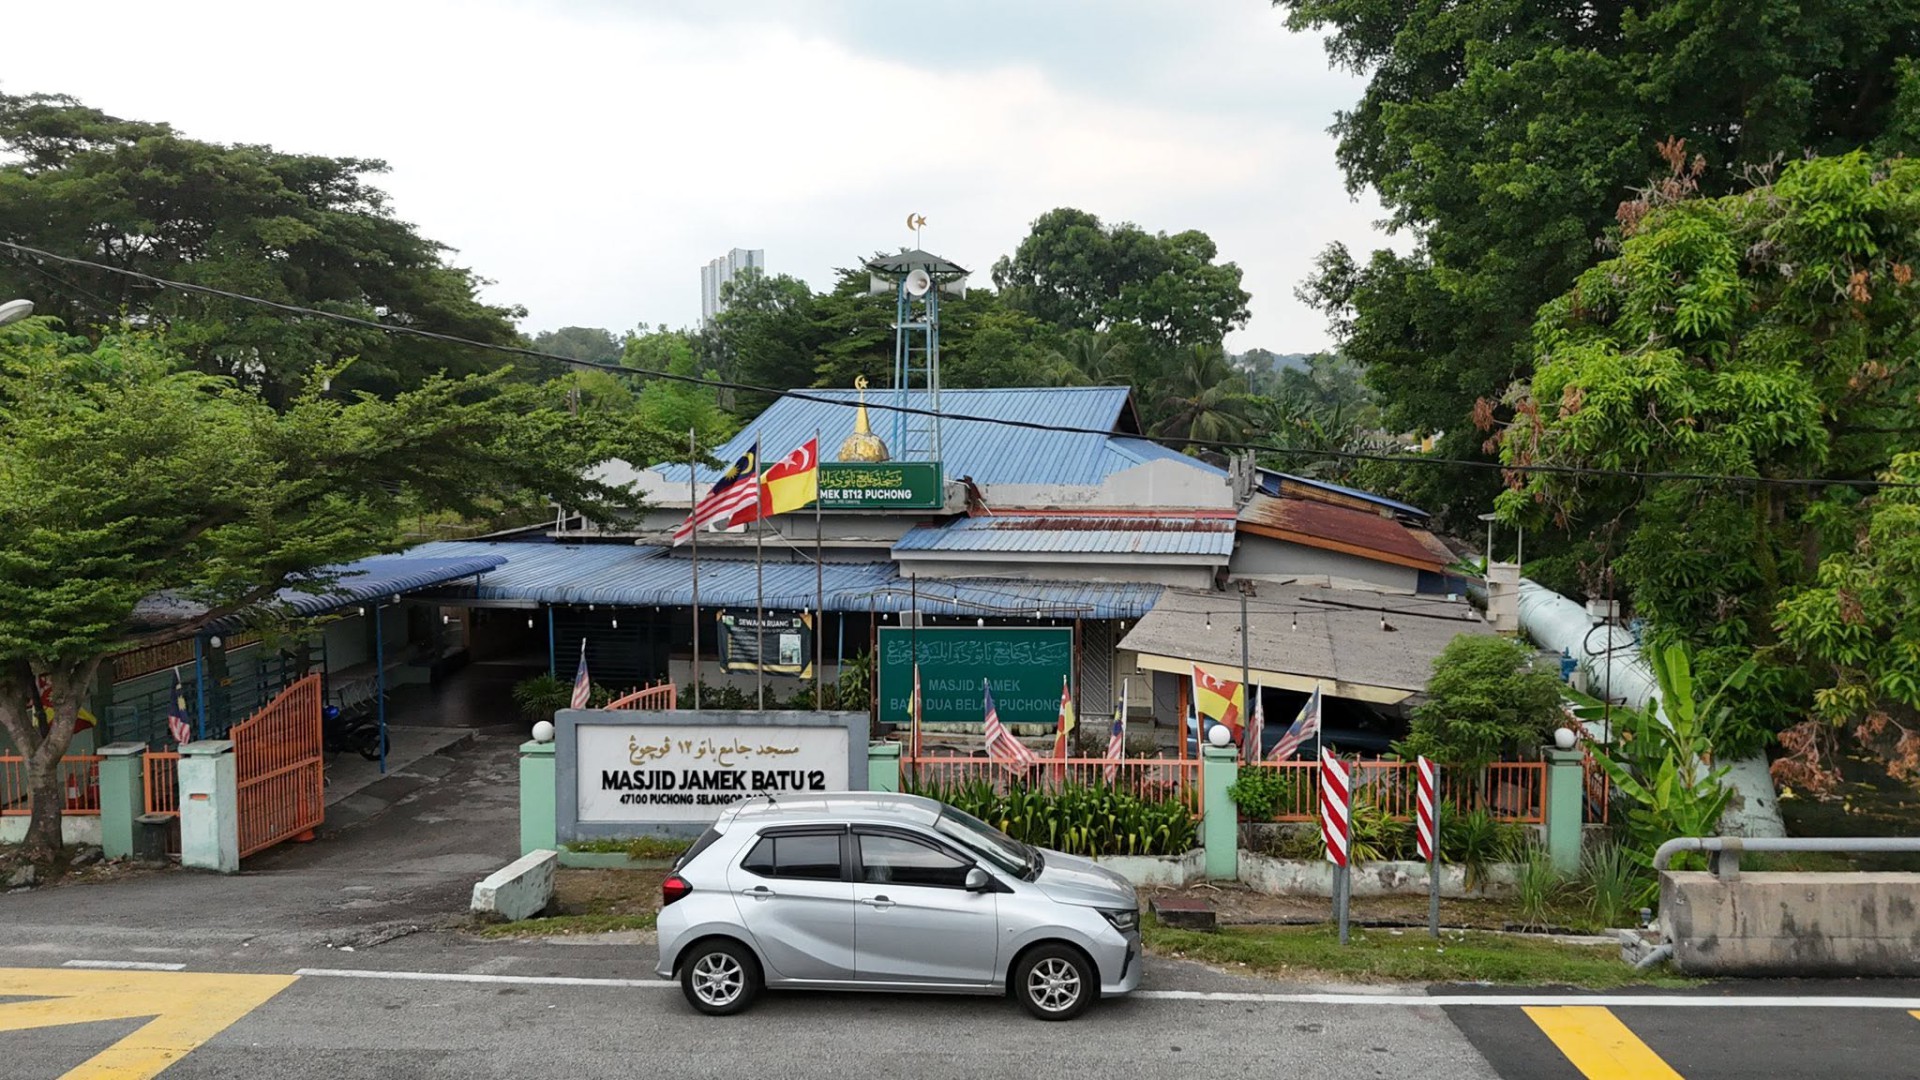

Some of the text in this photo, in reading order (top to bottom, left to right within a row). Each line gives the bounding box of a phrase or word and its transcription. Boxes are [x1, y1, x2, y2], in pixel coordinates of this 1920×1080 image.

[820, 489, 912, 499] MEK BT12 PUCHONG
[928, 679, 1021, 692] MASJID JAMEK
[890, 698, 1061, 711] BA DUA BEL PUCHONG
[694, 737, 716, 763] باتو
[718, 738, 753, 767] جامع
[756, 742, 799, 759] مسجد
[601, 770, 826, 790] MASJID JAMEK BATU 12
[619, 793, 648, 805] 47100
[650, 793, 694, 805] PUCHONG
